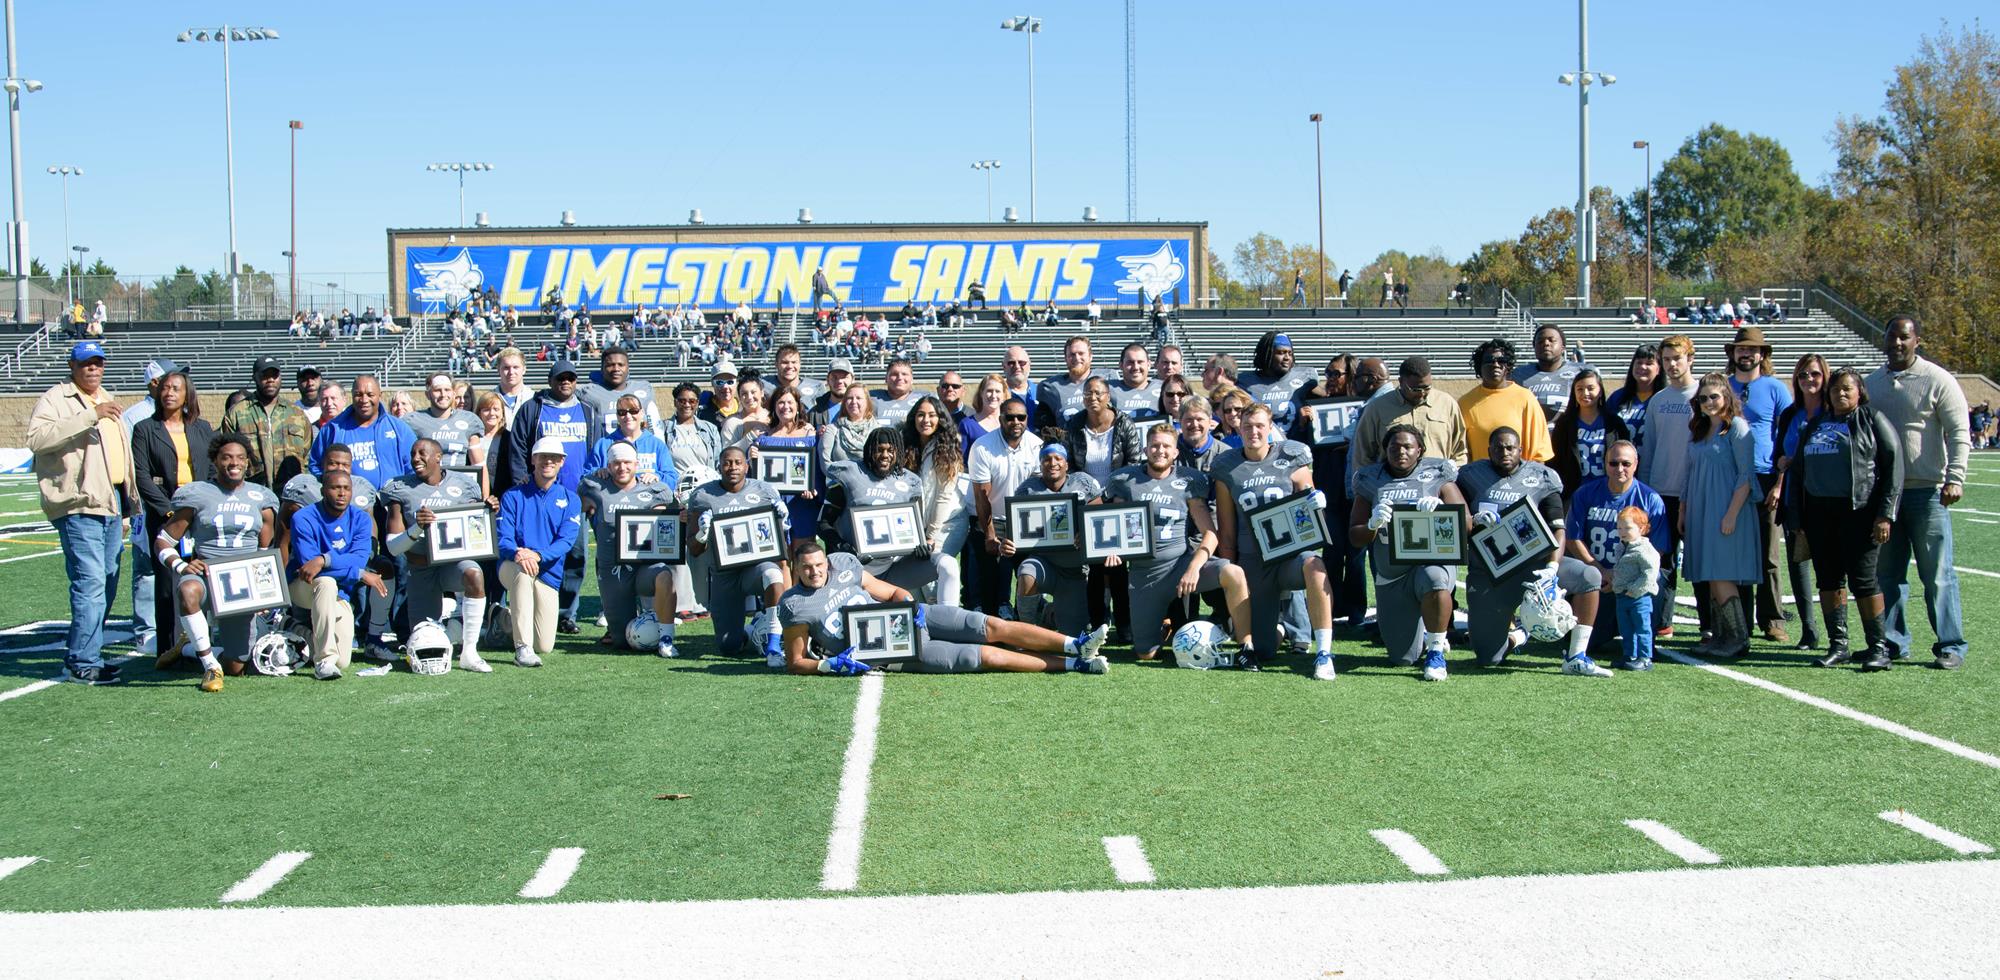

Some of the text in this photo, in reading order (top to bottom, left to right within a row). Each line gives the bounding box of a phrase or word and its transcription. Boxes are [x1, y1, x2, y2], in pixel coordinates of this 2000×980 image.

[500, 242, 1101, 306] LIMESTONE SAINTS
[1124, 399, 1151, 408] SAINTS
[1262, 391, 1289, 401] SAINTS
[432, 431, 460, 440] SAINTS
[1318, 411, 1341, 437] L
[763, 459, 784, 482] L
[1243, 476, 1276, 489] SAINTS
[866, 487, 896, 501] SAINTS
[1140, 492, 1173, 505] SAINTS
[1382, 489, 1418, 500] SAINTS
[1488, 490, 1521, 502] SAINTS
[217, 503, 251, 513] SAINTS
[213, 514, 254, 547] 17
[437, 521, 463, 550] L
[628, 523, 652, 551] L
[863, 519, 890, 545] L
[1019, 511, 1045, 540] L
[1092, 518, 1121, 549] L
[1160, 508, 1180, 539] 7
[1261, 517, 1293, 550] L
[1401, 519, 1428, 550] L
[722, 525, 751, 555] L
[1482, 535, 1519, 567] L
[219, 573, 250, 603] L
[824, 587, 851, 614] SAINTS
[857, 620, 884, 651] L
